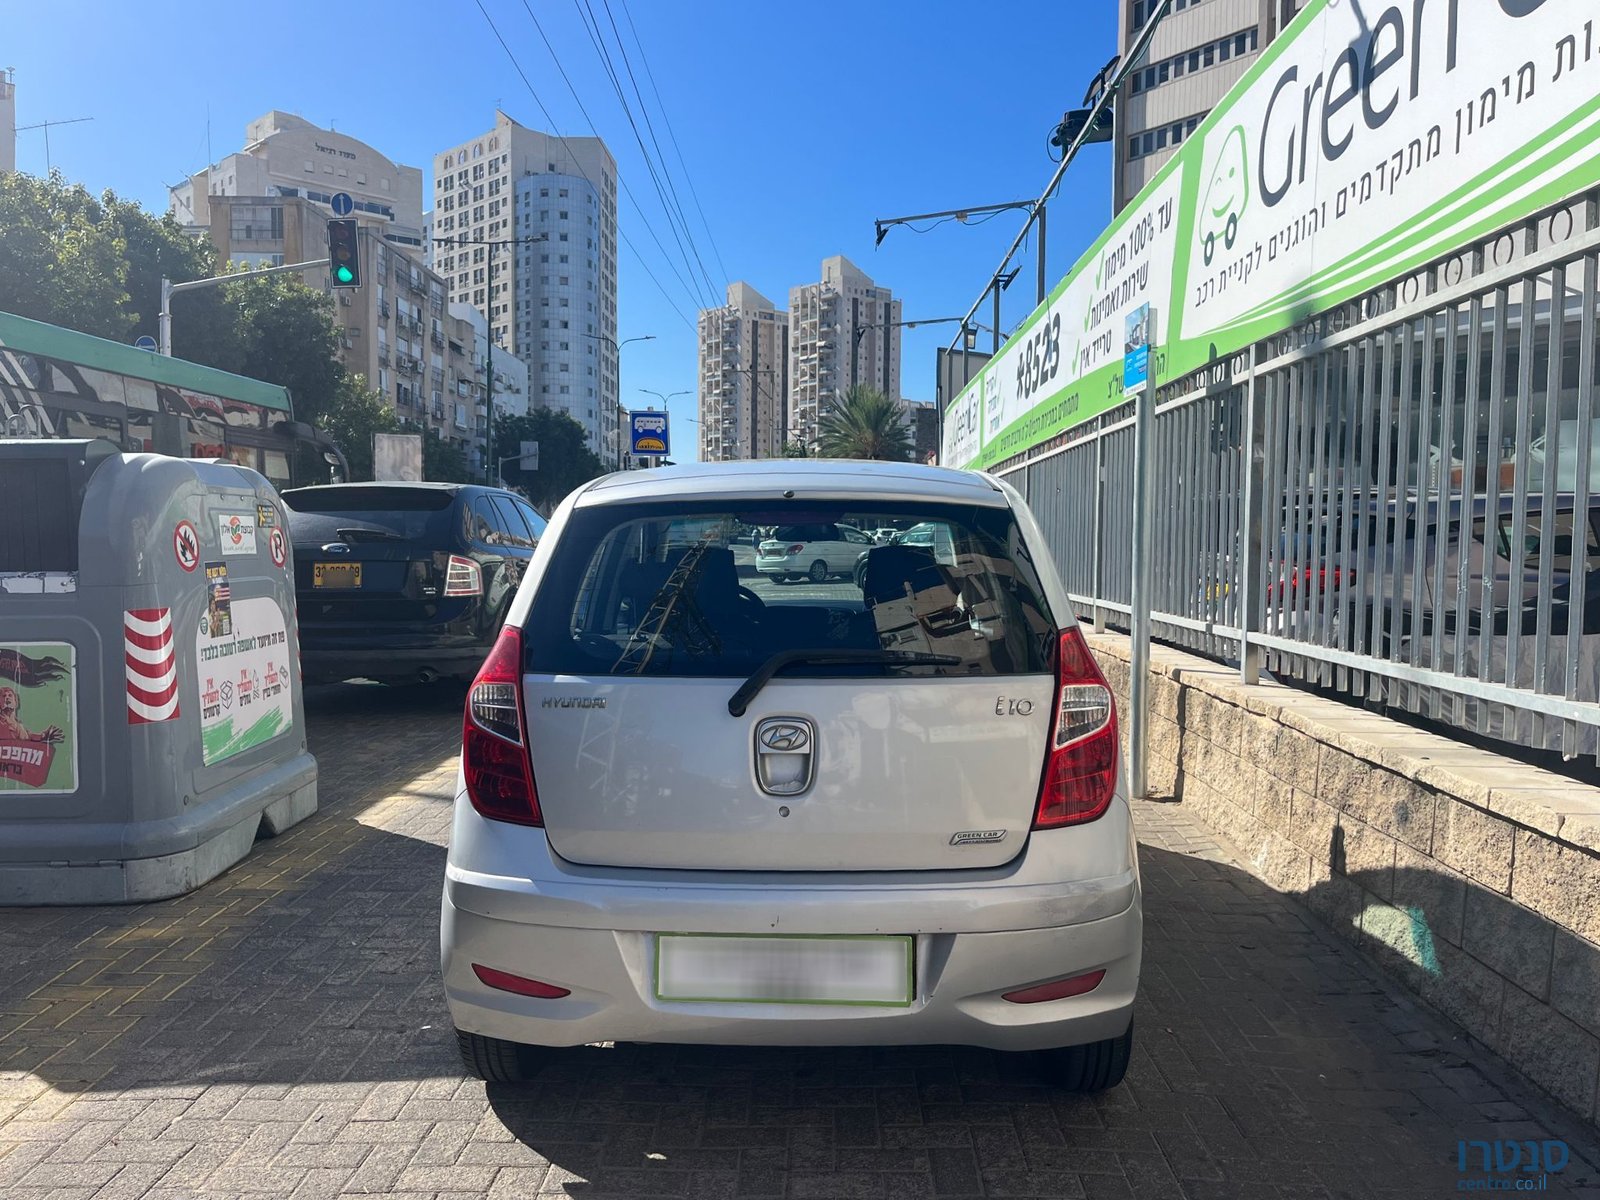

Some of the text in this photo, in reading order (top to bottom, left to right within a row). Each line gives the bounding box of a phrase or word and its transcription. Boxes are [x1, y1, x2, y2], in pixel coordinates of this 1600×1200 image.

[1258, 0, 1458, 208] Green
[1195, 19, 1600, 308] ות מימון מתקדמים והוגנים לקניית רכב
[1158, 197, 1172, 234] עד
[1104, 242, 1126, 290] מימון
[1090, 260, 1149, 331] שירות ואמינות
[1080, 344, 1090, 379] אין
[1092, 329, 1112, 363] טרייד
[220, 524, 254, 536] קבוצת אלון
[201, 644, 218, 662] בלבד!
[257, 634, 271, 648] מיועד
[272, 633, 277, 644] זה
[278, 631, 285, 643] פח
[0, 745, 44, 766] מהפכ
